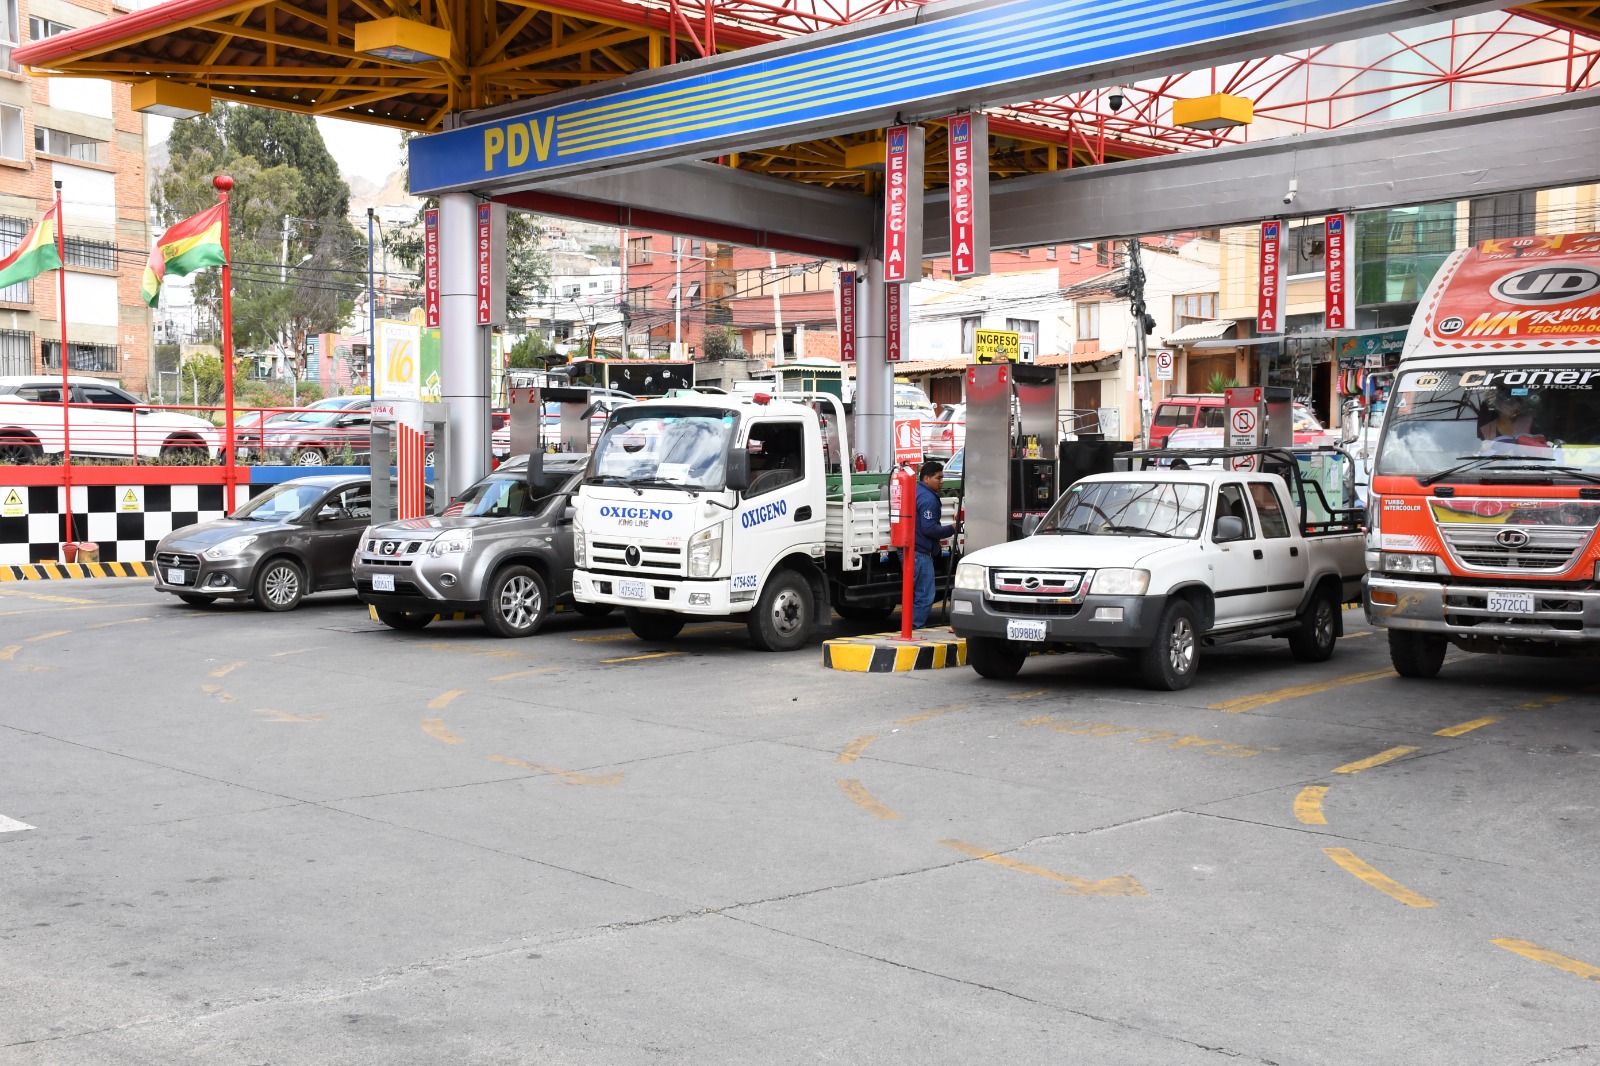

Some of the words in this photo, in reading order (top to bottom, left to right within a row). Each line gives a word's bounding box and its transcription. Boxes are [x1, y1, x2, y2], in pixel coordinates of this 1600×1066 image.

[484, 116, 555, 172] PDV
[888, 157, 903, 278] ESPECIAL
[956, 146, 970, 272] ESPECIAL
[429, 232, 437, 326] ESPECIAL
[480, 228, 488, 322] ESPECIAL
[1330, 237, 1341, 327] ESPECIAL
[1502, 272, 1598, 294] UD
[1261, 242, 1276, 330] ESPECIAL
[844, 288, 852, 360] ESPECIAL
[890, 286, 898, 359] ESPECIAL
[1442, 320, 1462, 329] UD
[1462, 310, 1539, 336] MK
[978, 334, 1017, 346] INGRESO
[388, 339, 414, 383] 16
[1161, 356, 1167, 365] E
[968, 367, 975, 384] 5
[998, 365, 1007, 383] 6
[1417, 377, 1439, 385] UD
[1459, 371, 1600, 386] Croner
[529, 390, 534, 403] 2
[1254, 388, 1260, 402] 8
[600, 506, 673, 520] OXIGENO
[742, 500, 786, 528] OXIGENO
[1500, 533, 1526, 544] UD
[733, 575, 757, 589] 4754-SCE
[620, 586, 644, 598] 4754SCE
[1491, 599, 1531, 612] 5572CCL
[1010, 626, 1044, 640] 3098BXC
